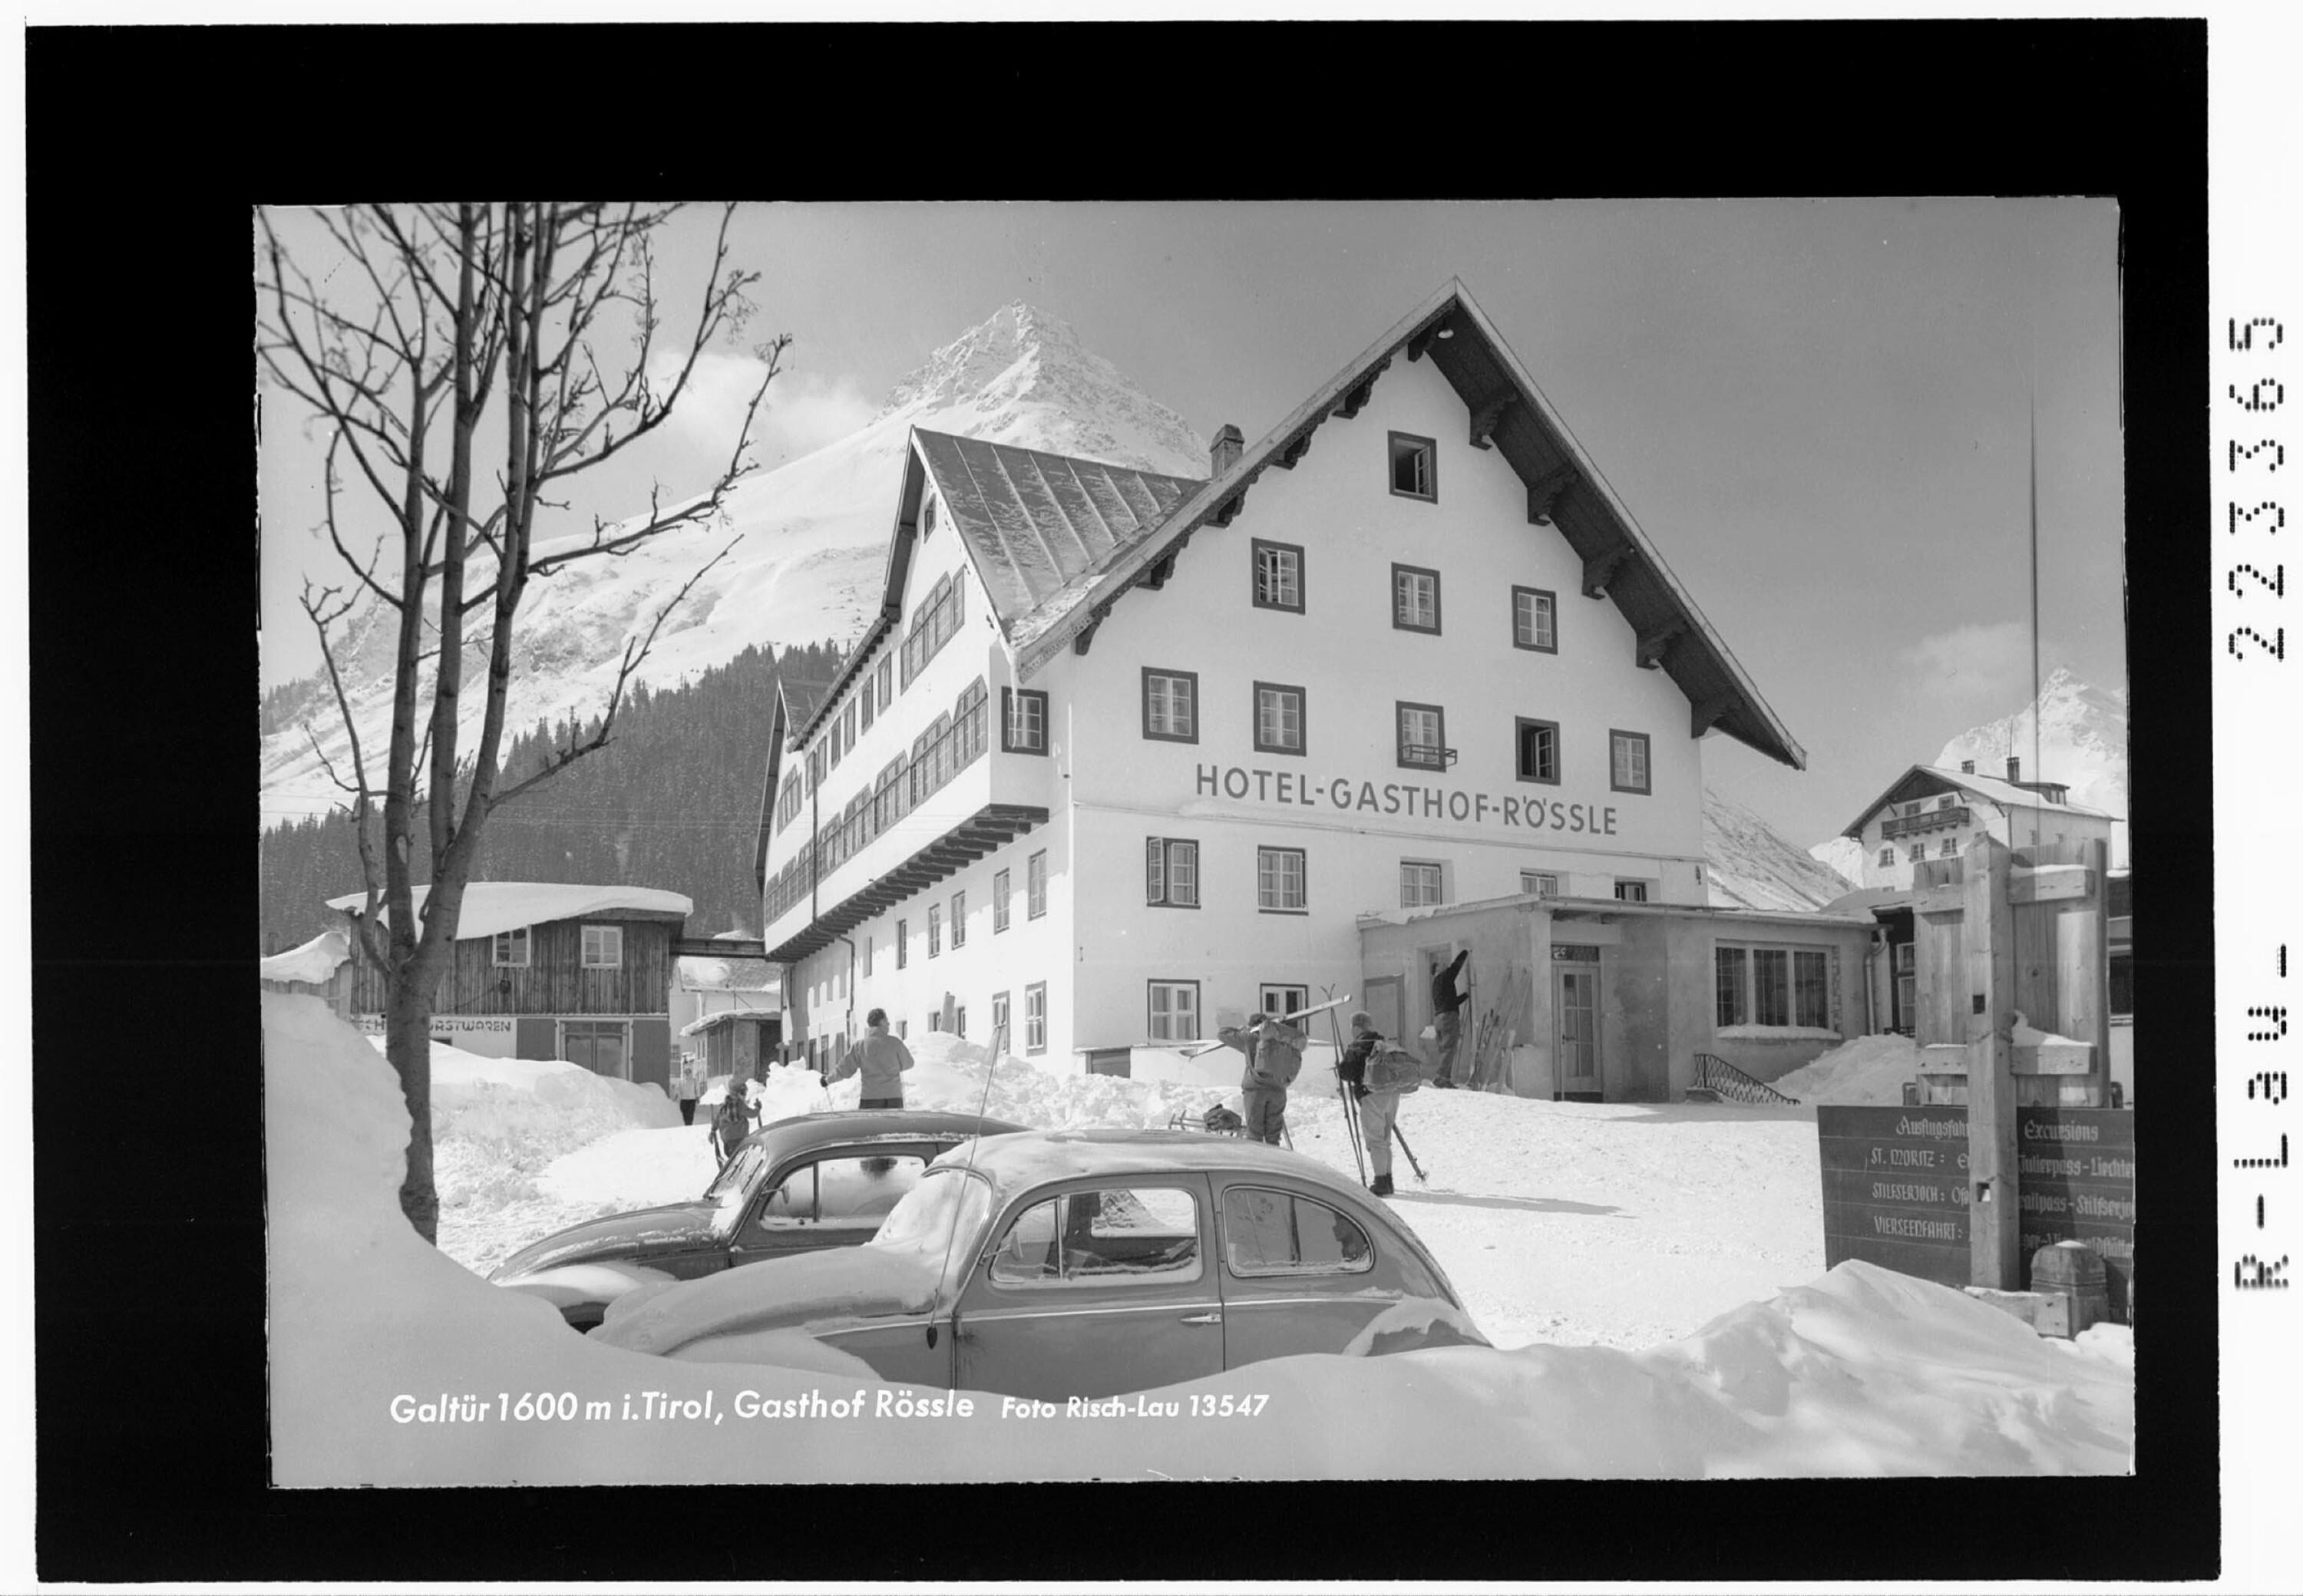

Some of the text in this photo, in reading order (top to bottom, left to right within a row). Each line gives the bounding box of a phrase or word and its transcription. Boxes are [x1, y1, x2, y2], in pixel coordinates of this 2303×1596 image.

[1197, 764, 1617, 835] HOTEL-GASTHOF-RÖSSLE
[2024, 1119, 2099, 1142] Excursions
[1870, 1148, 1887, 1165] ST.
